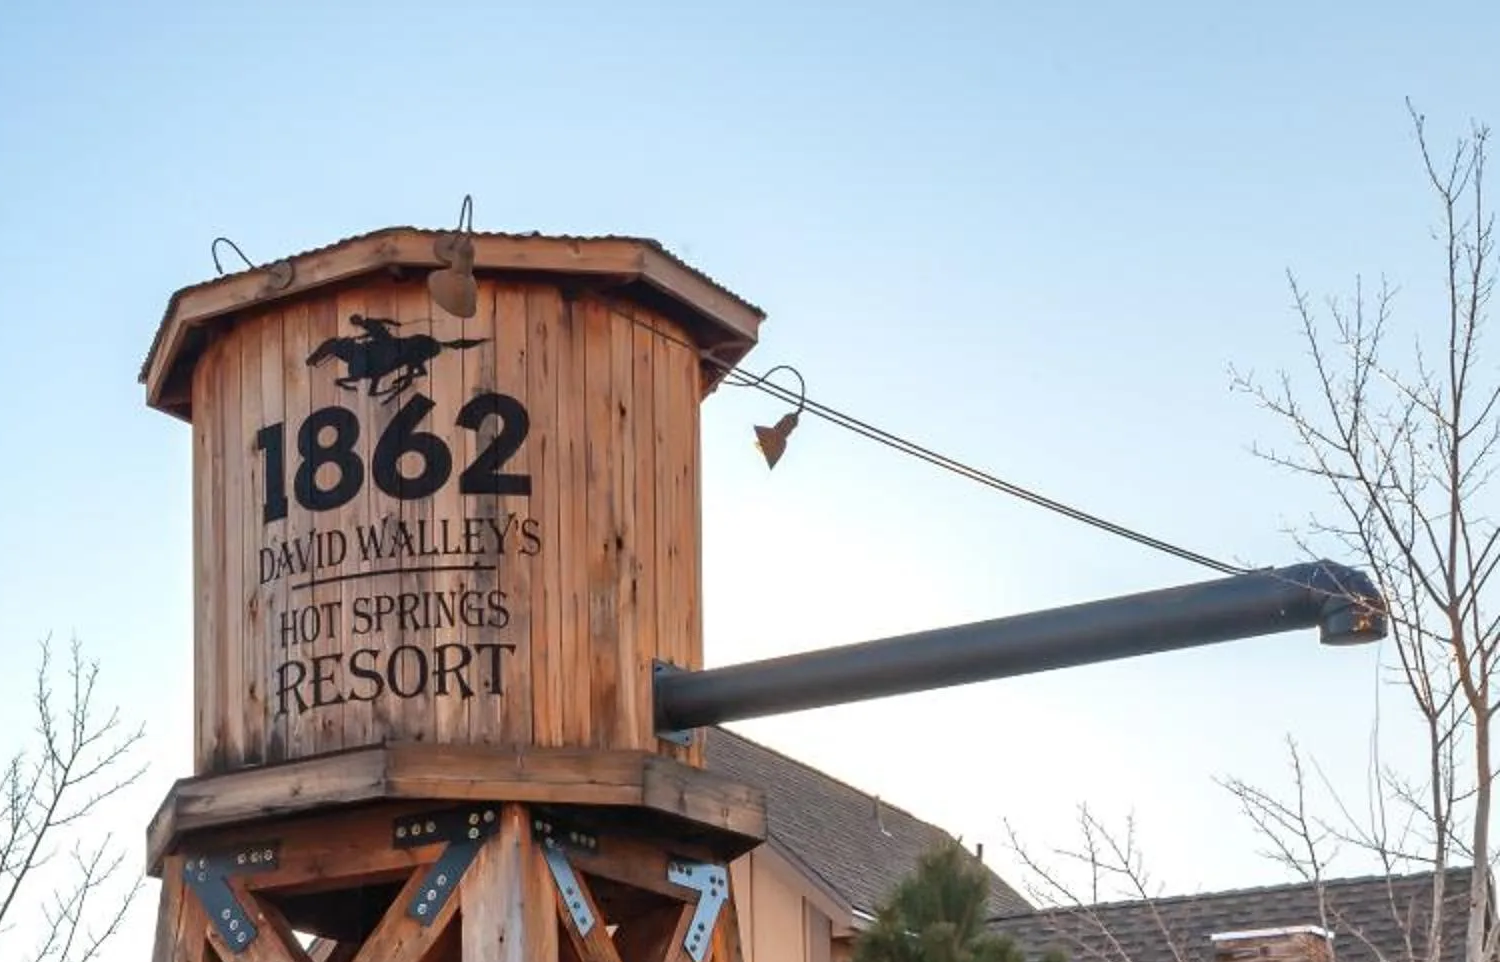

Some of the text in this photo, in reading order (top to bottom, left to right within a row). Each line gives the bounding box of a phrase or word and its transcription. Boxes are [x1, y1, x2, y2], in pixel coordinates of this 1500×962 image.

[257, 392, 532, 524] 1862
[259, 513, 541, 584] DAVID WALLEY'S
[280, 591, 510, 649] HOT SPRINGS
[276, 643, 516, 716] RESORT
